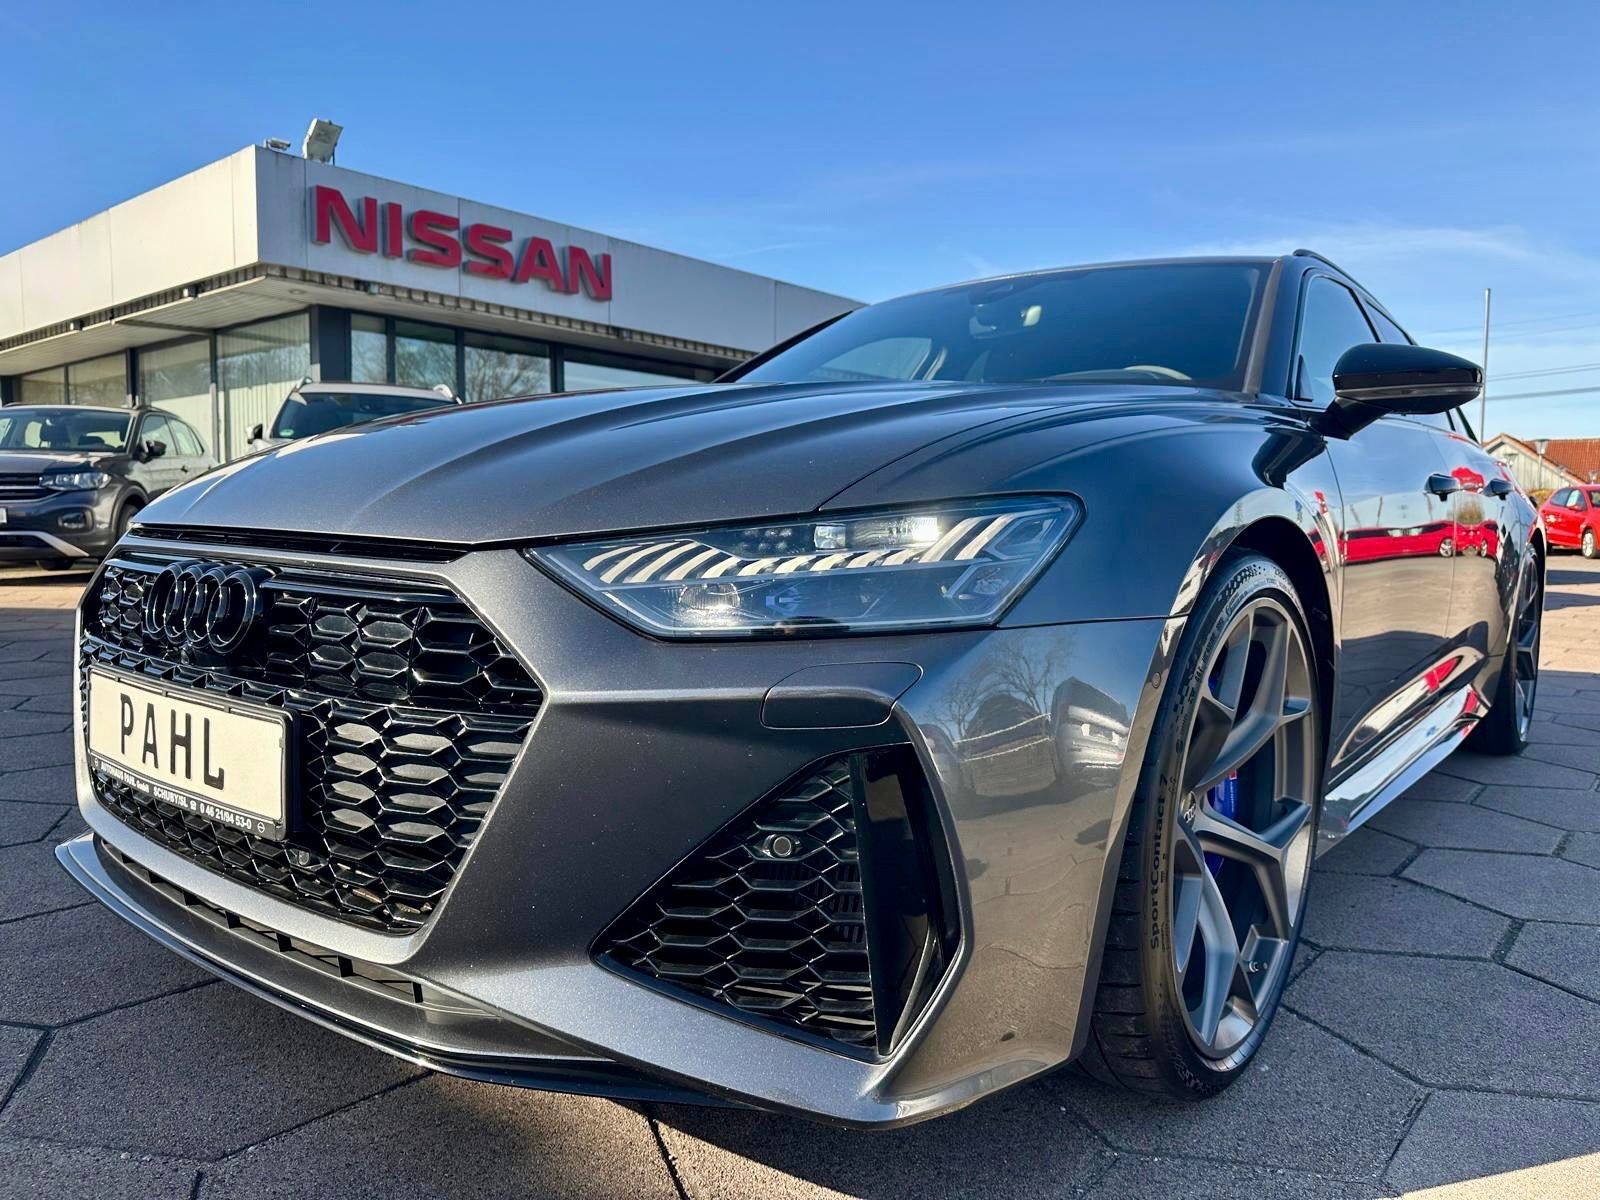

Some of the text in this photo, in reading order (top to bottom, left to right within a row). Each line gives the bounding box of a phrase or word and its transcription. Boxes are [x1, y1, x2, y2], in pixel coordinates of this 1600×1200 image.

[313, 185, 612, 301] NISSAN
[120, 693, 224, 790] PAHL
[235, 815, 252, 830] 53-0
[1151, 794, 1165, 950] SportContact
